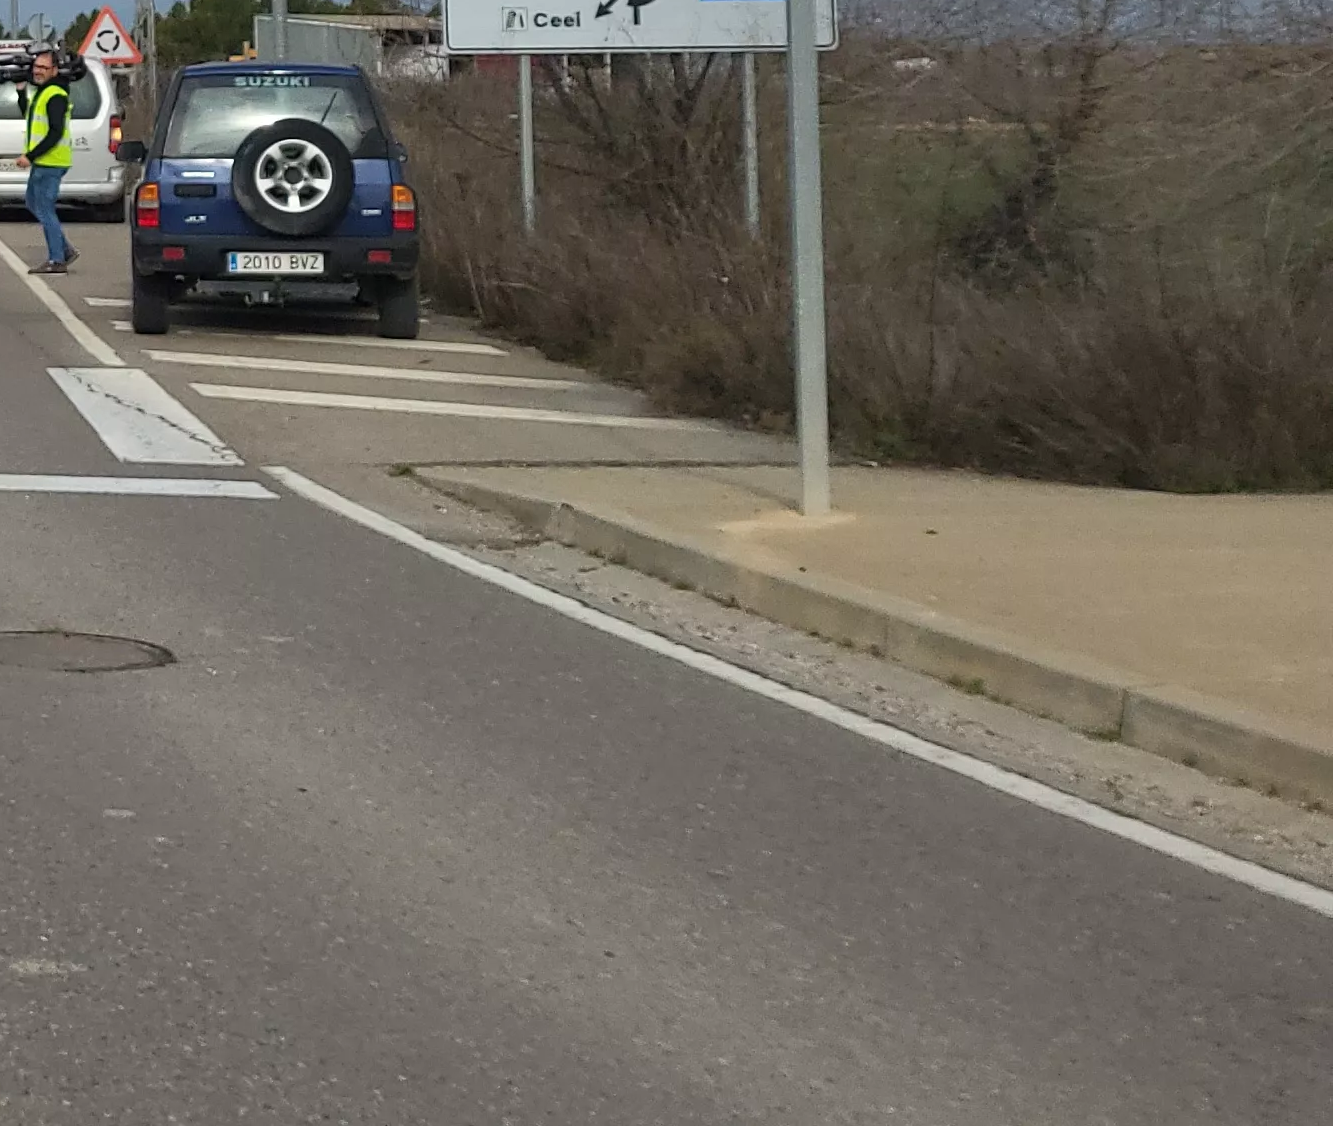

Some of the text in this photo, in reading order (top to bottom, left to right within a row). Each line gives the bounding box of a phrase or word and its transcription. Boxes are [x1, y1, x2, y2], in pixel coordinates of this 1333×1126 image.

[534, 11, 581, 28] Ceel
[234, 76, 311, 86] SUZUKI
[243, 255, 320, 270] 2010 BVZ
